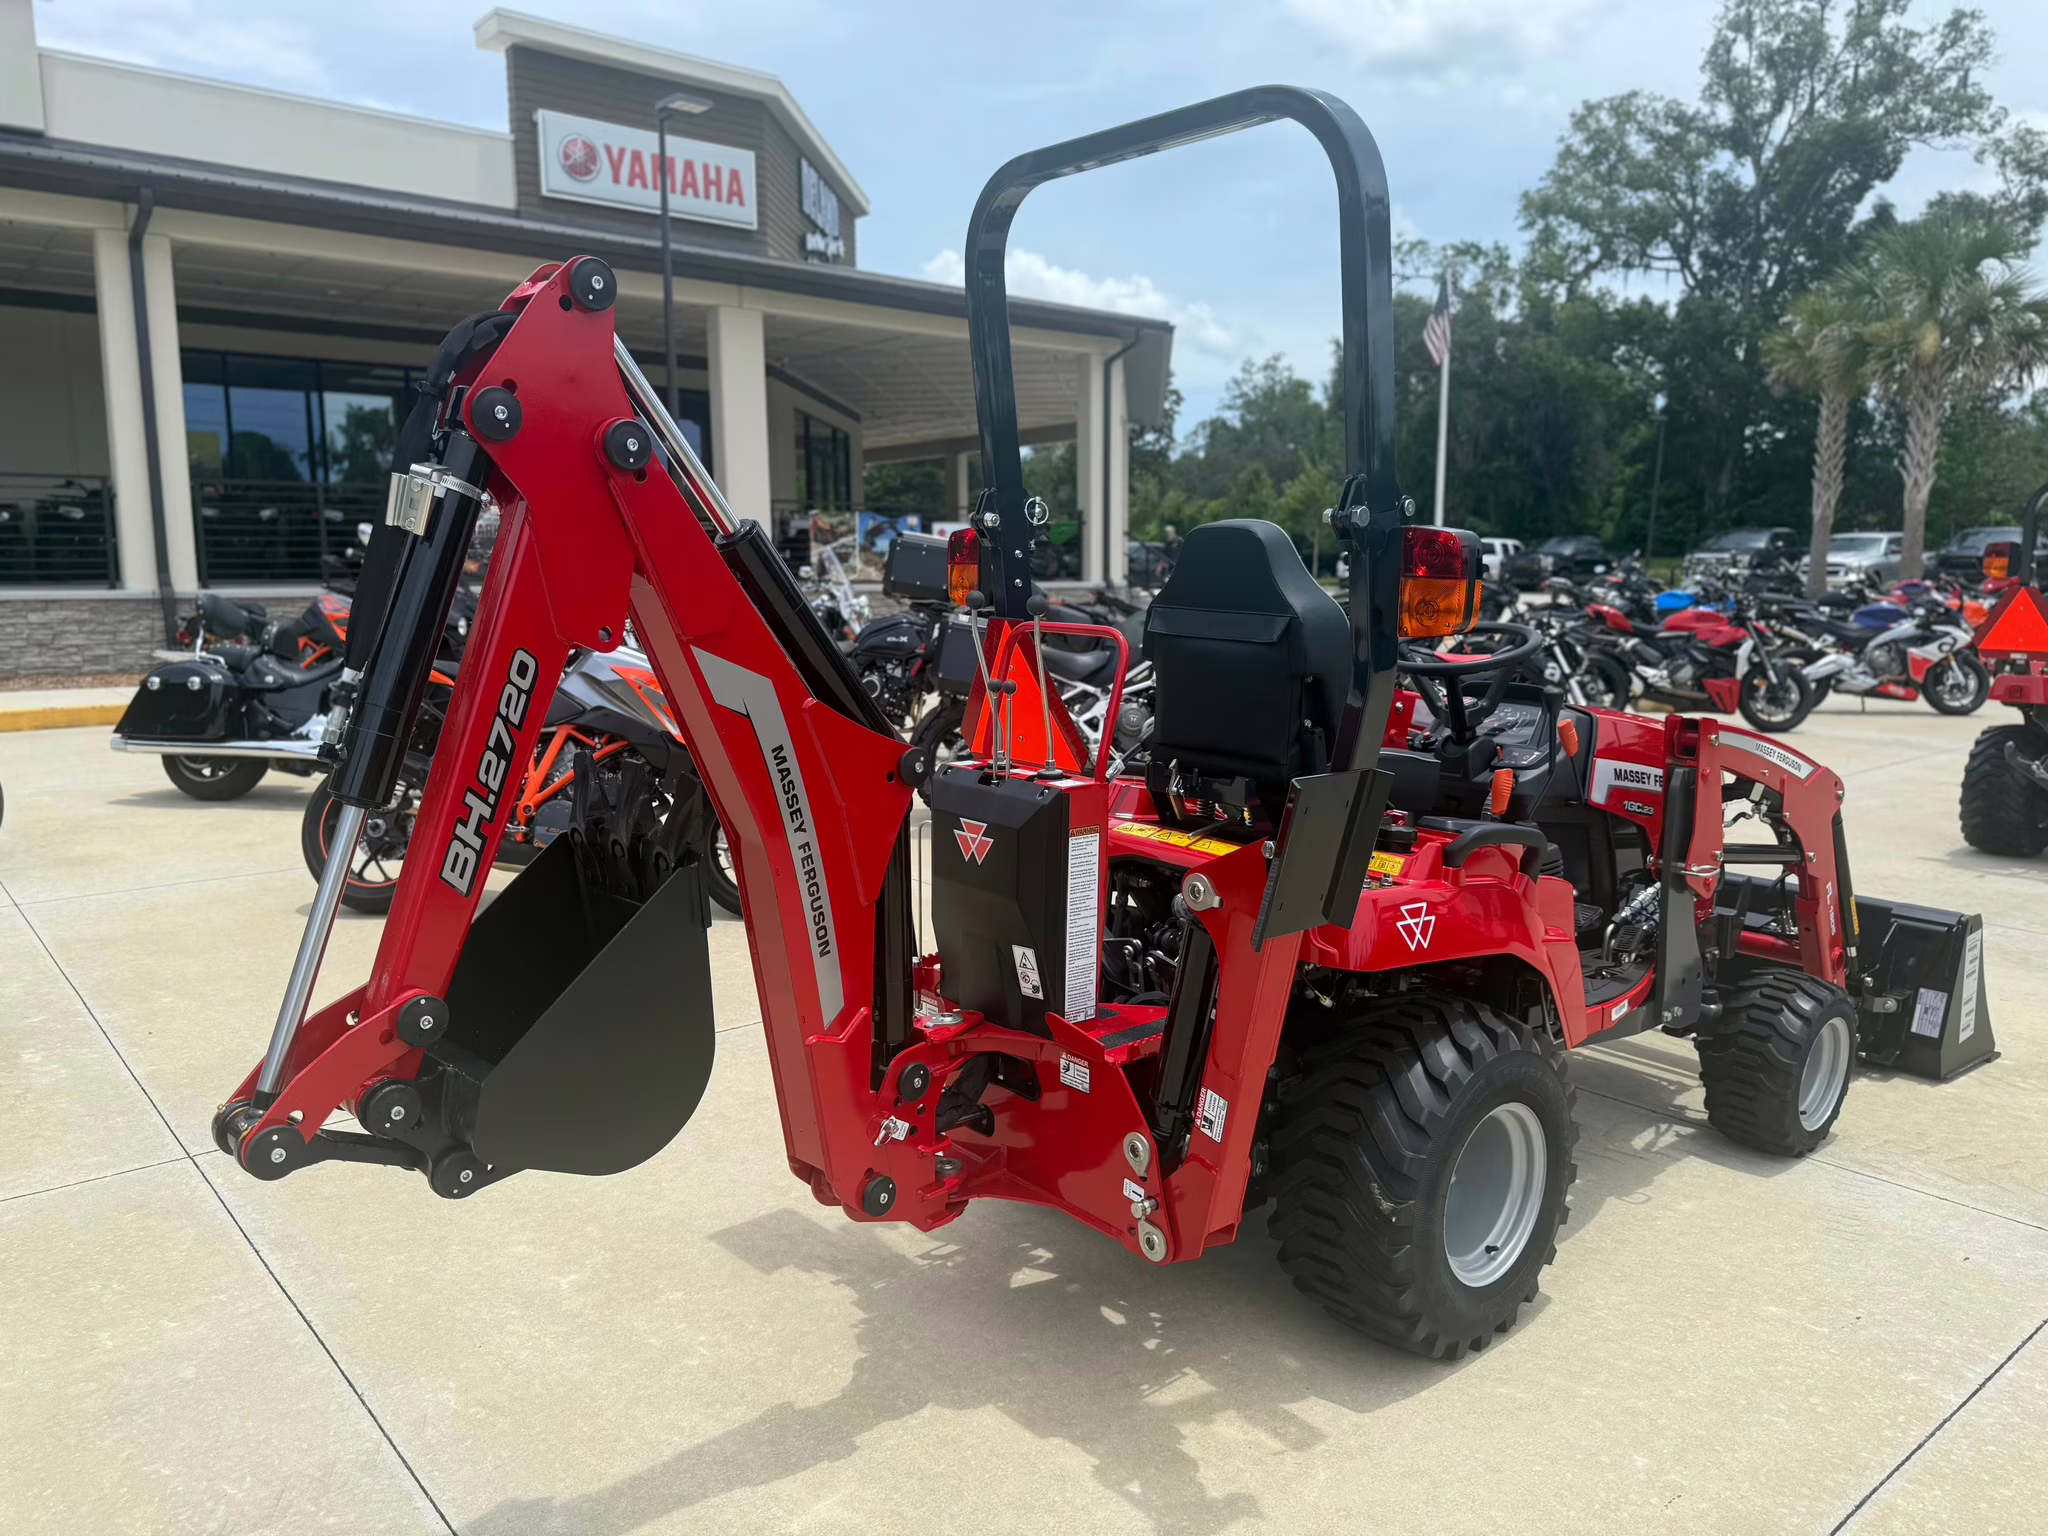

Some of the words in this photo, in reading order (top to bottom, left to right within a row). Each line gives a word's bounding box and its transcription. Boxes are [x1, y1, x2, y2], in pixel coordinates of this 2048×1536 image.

[603, 143, 746, 207] YAMAHA
[440, 648, 538, 896] BH.2720
[1755, 742, 1776, 758] MASSEY
[1776, 751, 1802, 773] FERGUSON
[1613, 767, 1651, 786] MASSEY
[1074, 825, 1099, 836] WARNING
[771, 743, 807, 834] MASSEY
[798, 840, 831, 958] FERGUSON
[1067, 1055, 1089, 1068] DANGER
[1197, 1087, 1207, 1118] DANGER
